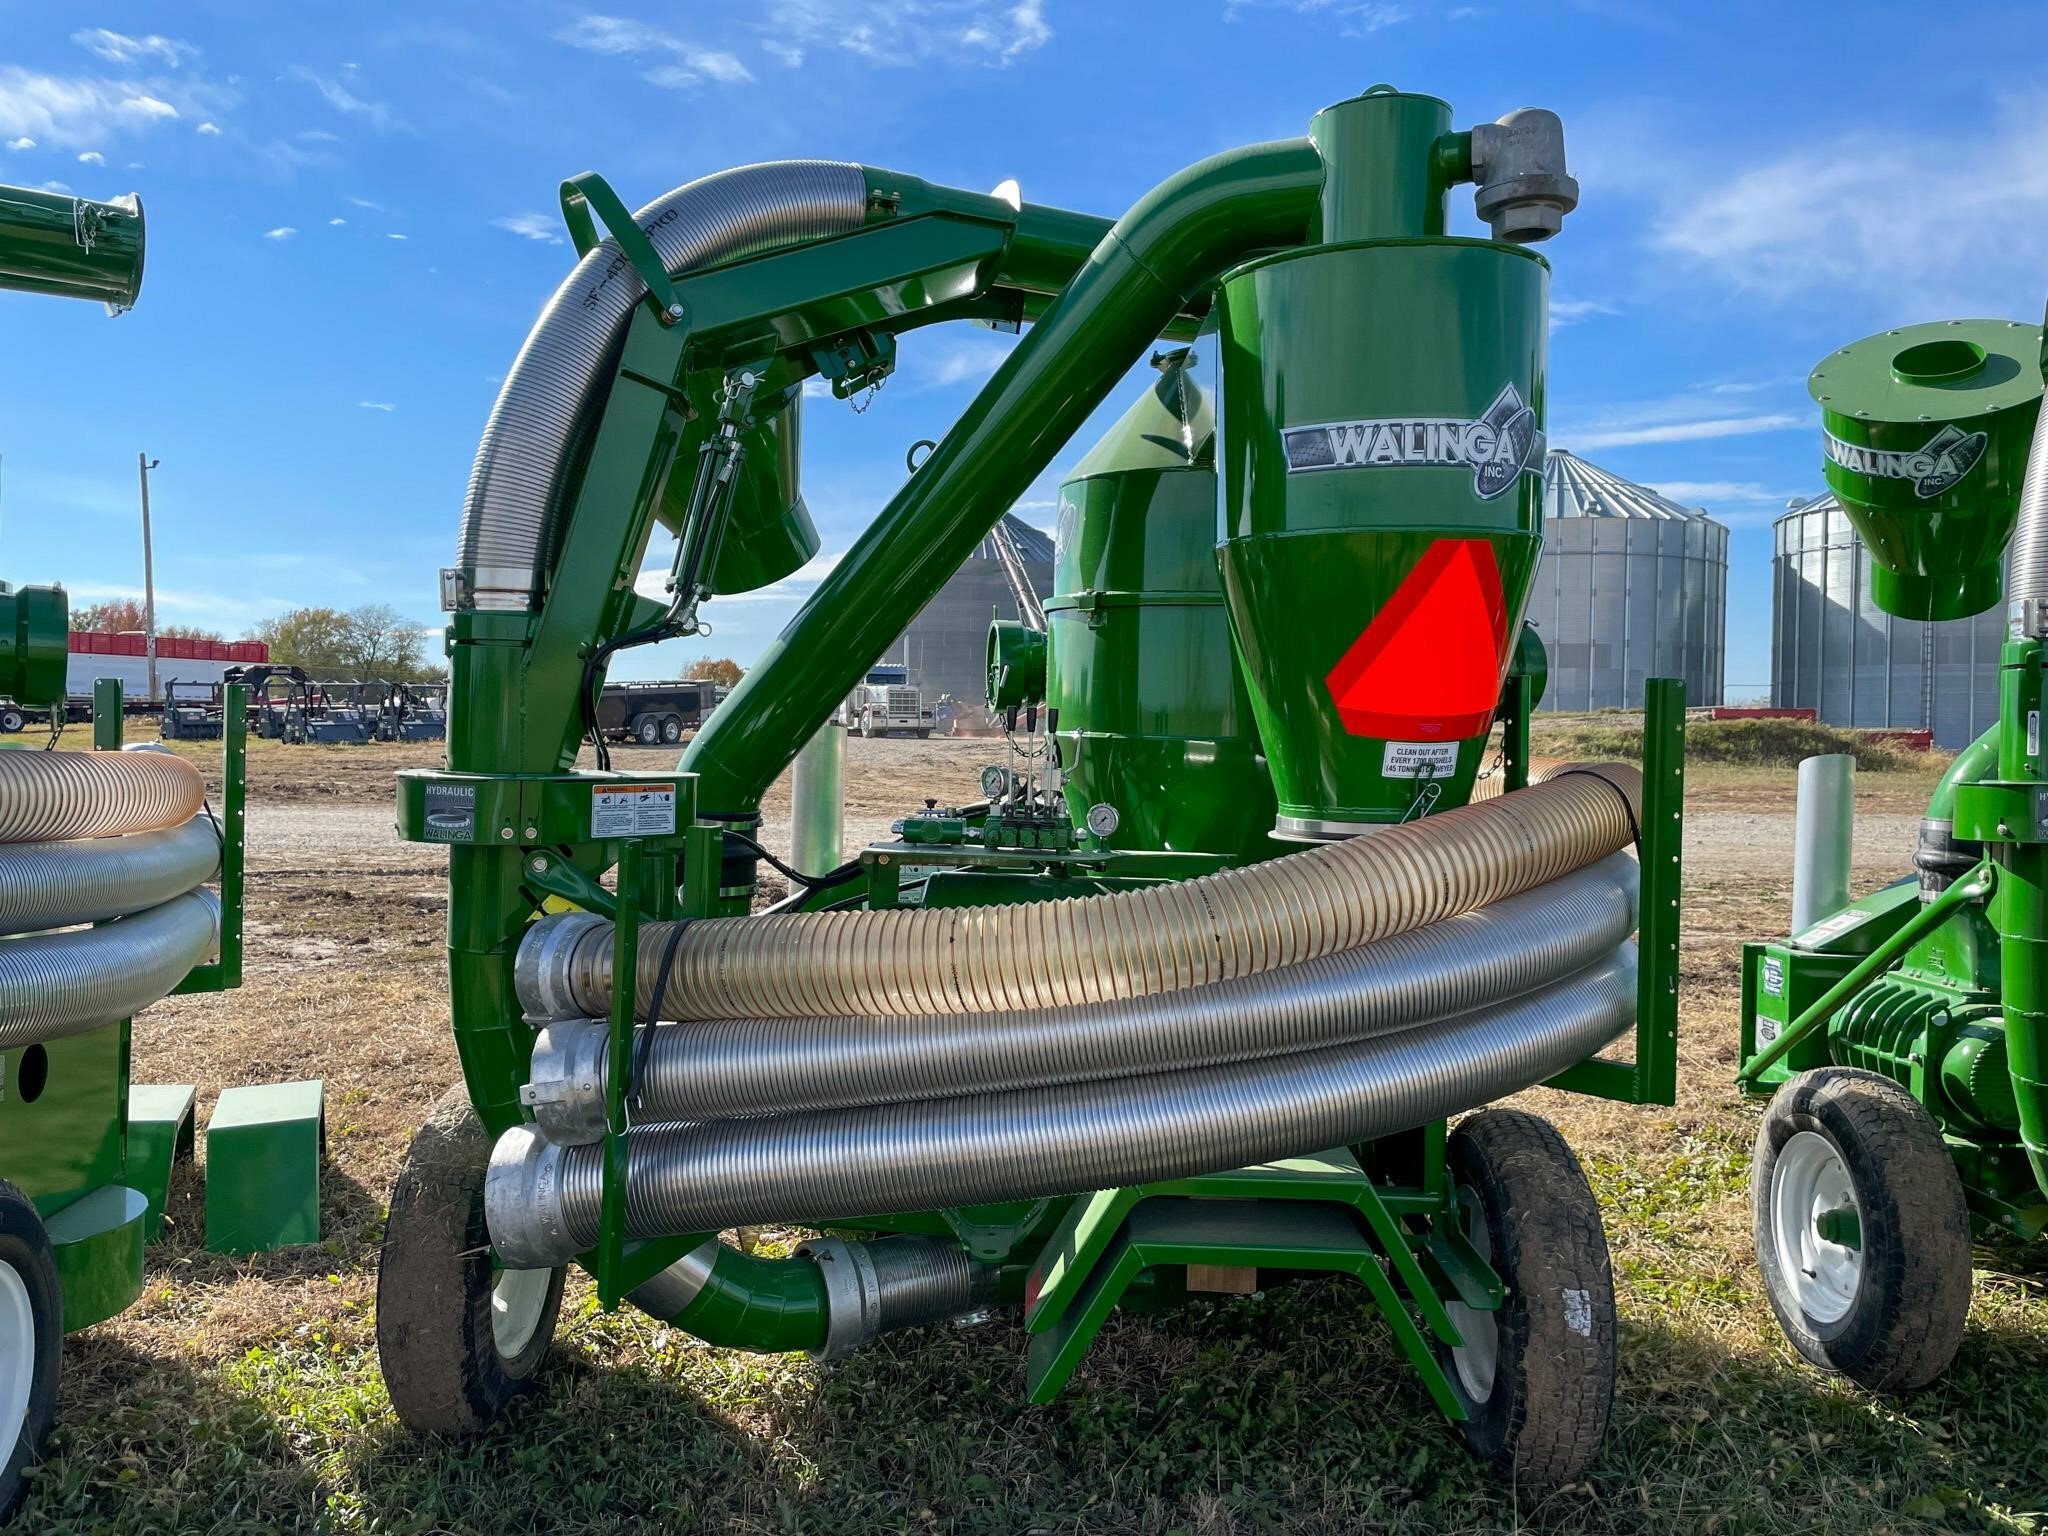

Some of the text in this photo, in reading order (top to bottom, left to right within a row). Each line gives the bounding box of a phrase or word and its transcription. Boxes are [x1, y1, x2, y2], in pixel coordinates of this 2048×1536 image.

[1328, 423, 1516, 464] WALINGA
[1831, 439, 1958, 476] WALINGA
[1484, 465, 1505, 479] INC.
[1924, 477, 1945, 487] INC.
[1396, 748, 1449, 756] CLEAN OUT AFTER
[1390, 756, 1411, 765] EVERY
[1428, 756, 1452, 765] BUSHELS
[1385, 765, 1397, 773] (45
[426, 785, 474, 796] HYDRAULIC
[425, 829, 472, 839] WALINGA
